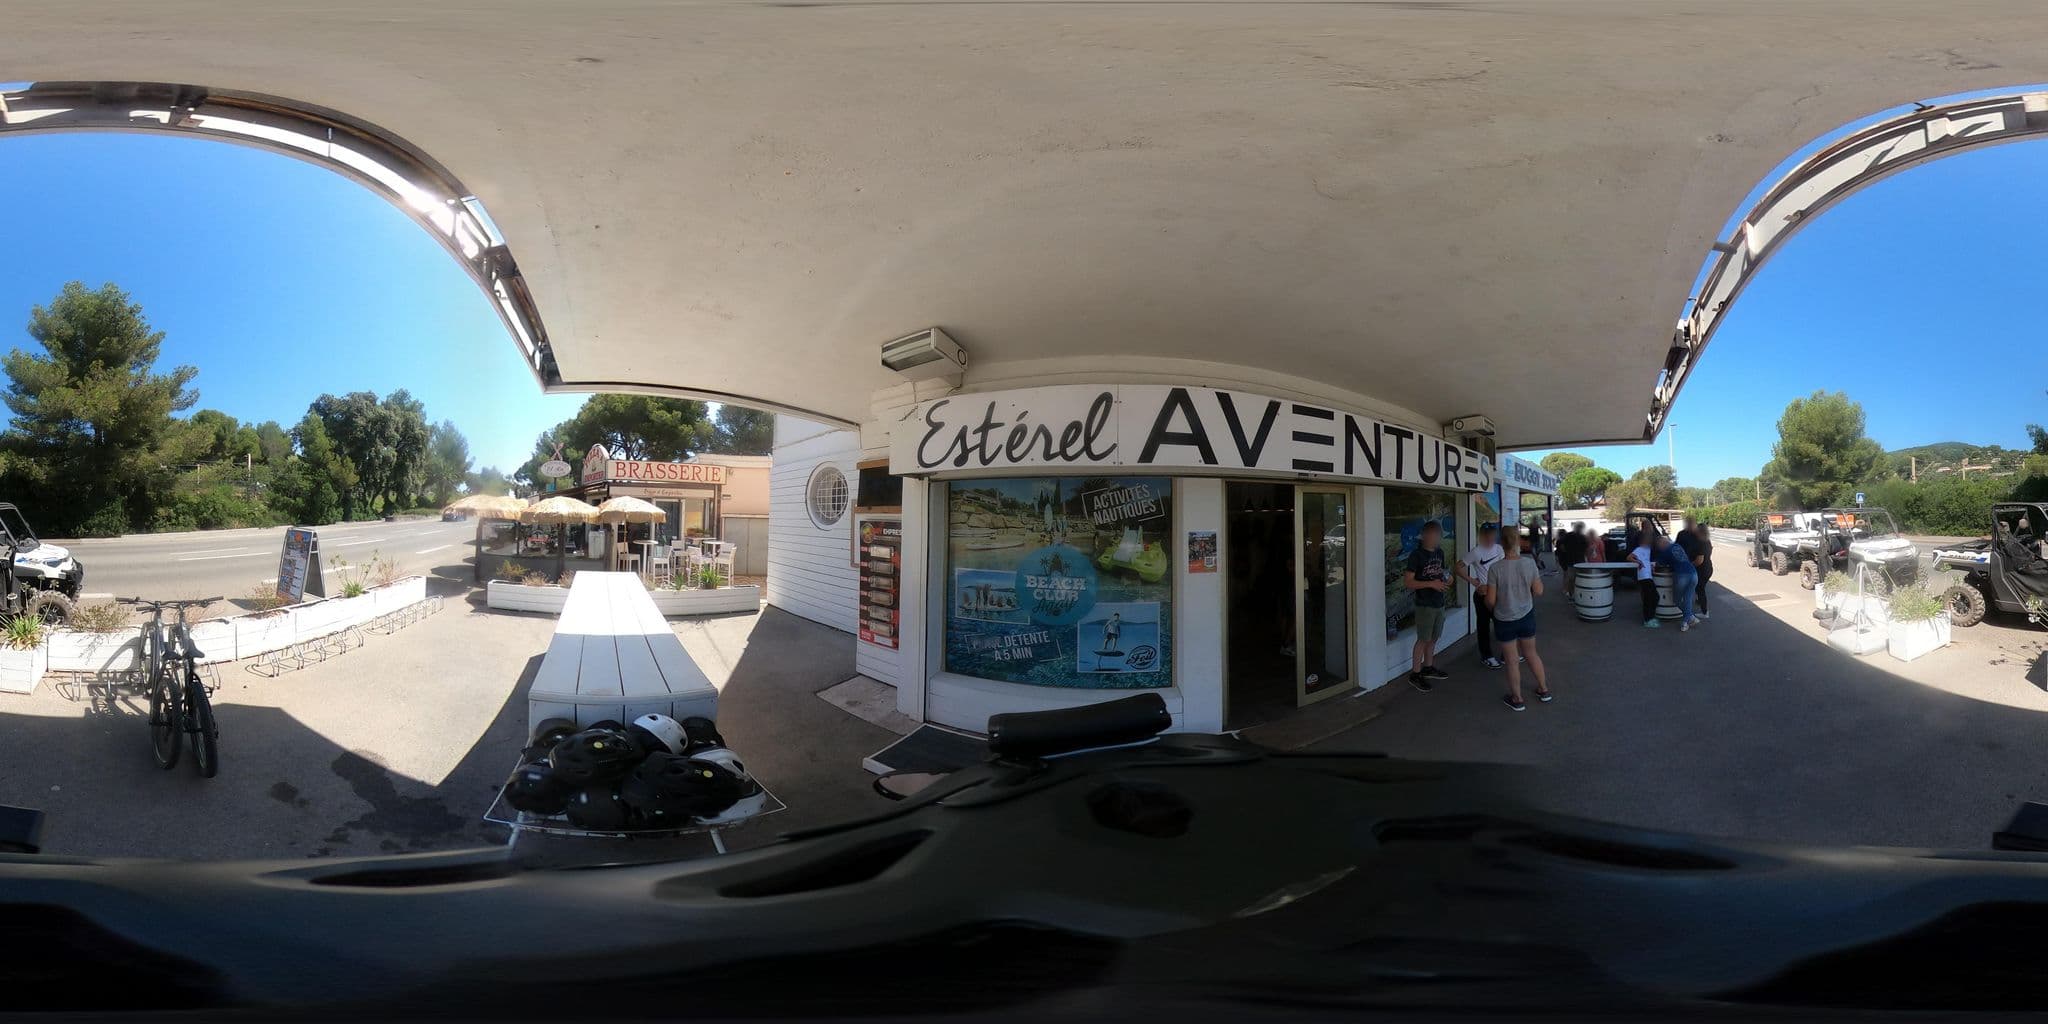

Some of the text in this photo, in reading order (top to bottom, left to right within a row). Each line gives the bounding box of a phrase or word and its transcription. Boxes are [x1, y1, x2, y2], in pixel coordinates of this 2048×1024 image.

[917, 387, 1490, 492] Estérel AVENTURES
[615, 461, 721, 482] BRASSERIE
[1093, 483, 1150, 510] ACTIVITÉS
[1093, 499, 1157, 526] NAUTIQUES
[1026, 575, 1087, 591] BEACH
[1033, 589, 1079, 602] CLUB
[1004, 649, 1010, 660] 5
[1012, 646, 1033, 660] MIN
